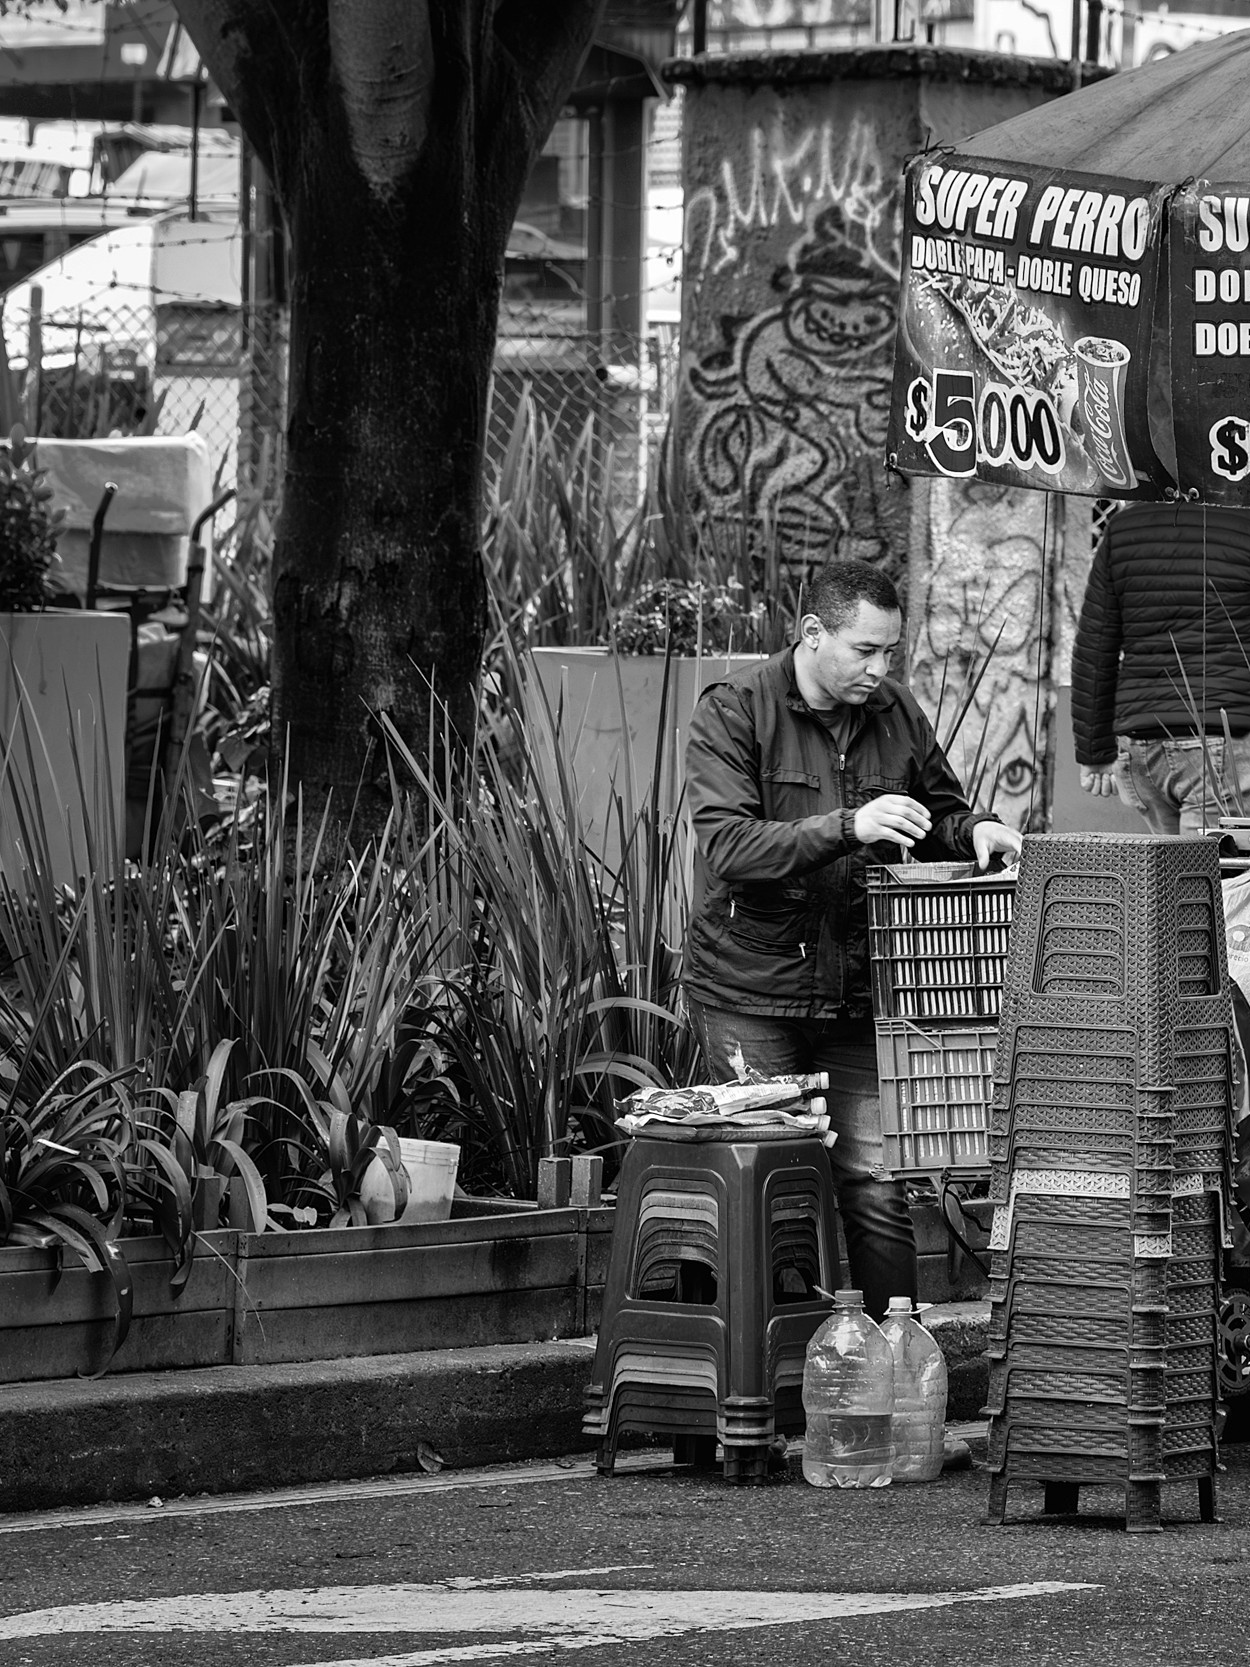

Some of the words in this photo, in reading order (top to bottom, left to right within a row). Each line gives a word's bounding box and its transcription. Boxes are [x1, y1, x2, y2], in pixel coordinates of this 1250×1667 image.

[915, 165, 1029, 240] SUPER
[1030, 185, 1150, 261] PERRO
[911, 235, 964, 273] DOBLE
[965, 246, 1005, 284] PAPA
[1017, 255, 1071, 296] DOBLE
[1078, 265, 1141, 307] QUESO
